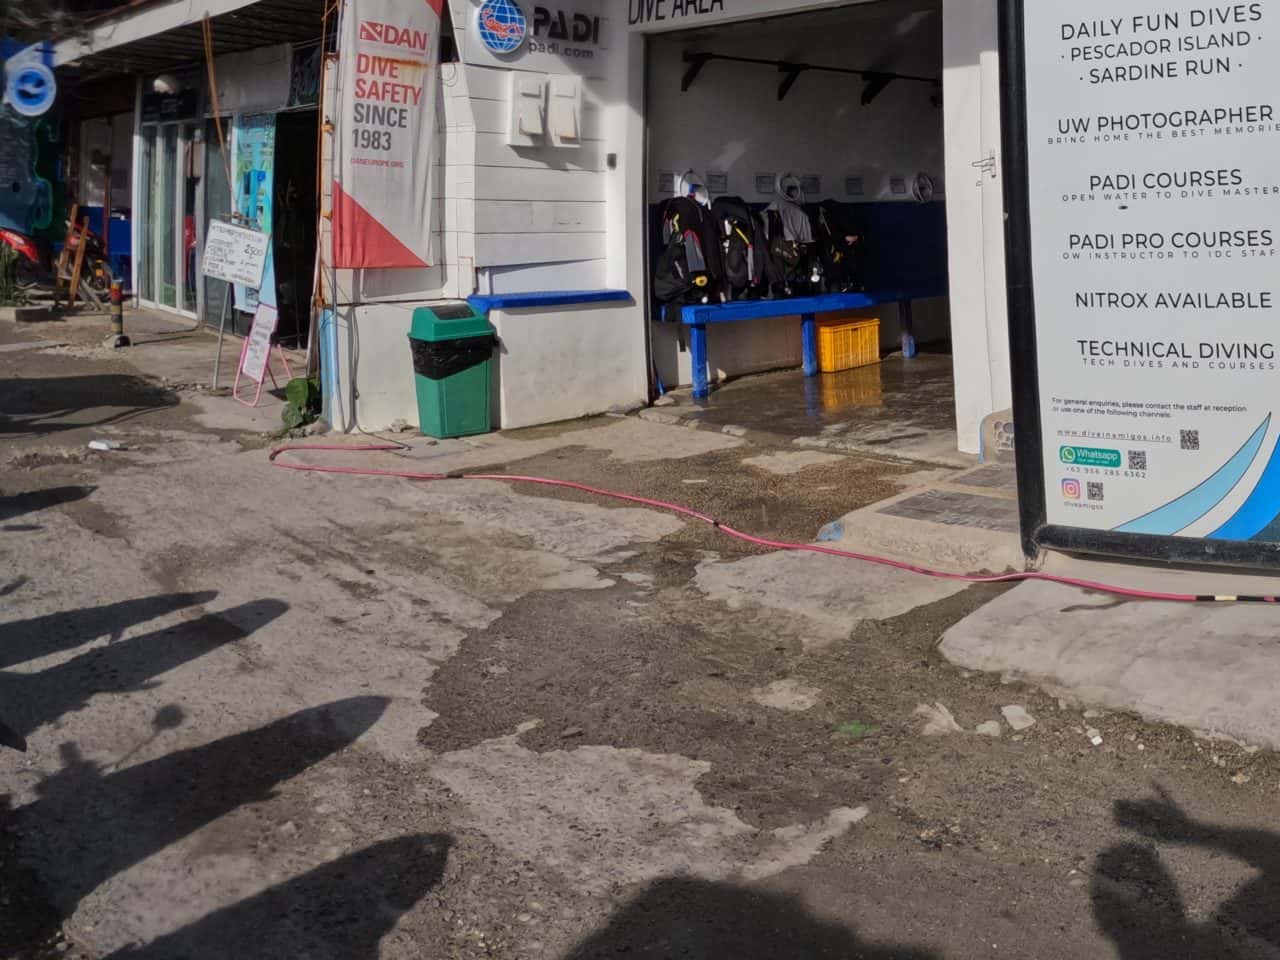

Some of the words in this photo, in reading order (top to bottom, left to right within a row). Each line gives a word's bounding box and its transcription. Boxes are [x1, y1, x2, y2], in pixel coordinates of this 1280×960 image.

[533, 5, 600, 45] PADI
[1061, 17, 1123, 41] DAILY
[1132, 12, 1179, 33] FUN
[1190, 3, 1263, 27] DIVES
[383, 23, 428, 51] DAN
[1070, 38, 1171, 62] PESCADOR
[1178, 30, 1251, 51] ISLAND
[528, 41, 594, 58] padi.com
[355, 52, 399, 79] DIVE
[1089, 62, 1178, 84] SARDINE
[1186, 57, 1230, 76] RUN
[354, 78, 422, 107] SAFETY
[353, 102, 409, 129] SINCE
[1057, 118, 1090, 134] UW
[1098, 104, 1274, 132] PHOTOGRAPHER
[352, 127, 392, 152] 1983
[1048, 135, 1086, 145] BRING
[1094, 132, 1130, 142] HOME
[1138, 130, 1163, 140] THE
[1171, 128, 1205, 138] BEST
[1090, 174, 1136, 191] PADI
[1143, 168, 1242, 190] COURSES
[1062, 193, 1095, 202] OPEN
[1103, 191, 1148, 201] WATER
[1156, 190, 1172, 200] TO
[1181, 188, 1214, 199] DIVE
[1223, 186, 1280, 197] MASTER
[1069, 234, 1114, 249] PADI
[1122, 232, 1164, 249] PRO
[1171, 229, 1273, 248] COURSES
[1062, 252, 1081, 260] OW
[1089, 250, 1174, 260] INSTRUCTOR
[1183, 250, 1199, 259] TO
[1208, 249, 1232, 258] IDC
[1075, 292, 1149, 309] NITROX
[1154, 291, 1273, 309] AVAILABLE
[1077, 339, 1192, 359] TECHNICAL
[1199, 342, 1275, 360] DIVING
[1082, 357, 1115, 367] TECH
[1123, 359, 1163, 368] DIVES
[1172, 360, 1199, 369] AND
[1208, 361, 1276, 370] COURSES
[1063, 398, 1088, 407] general
[1121, 400, 1144, 410] please
[1144, 402, 1171, 410] contact
[1186, 403, 1202, 411] staff
